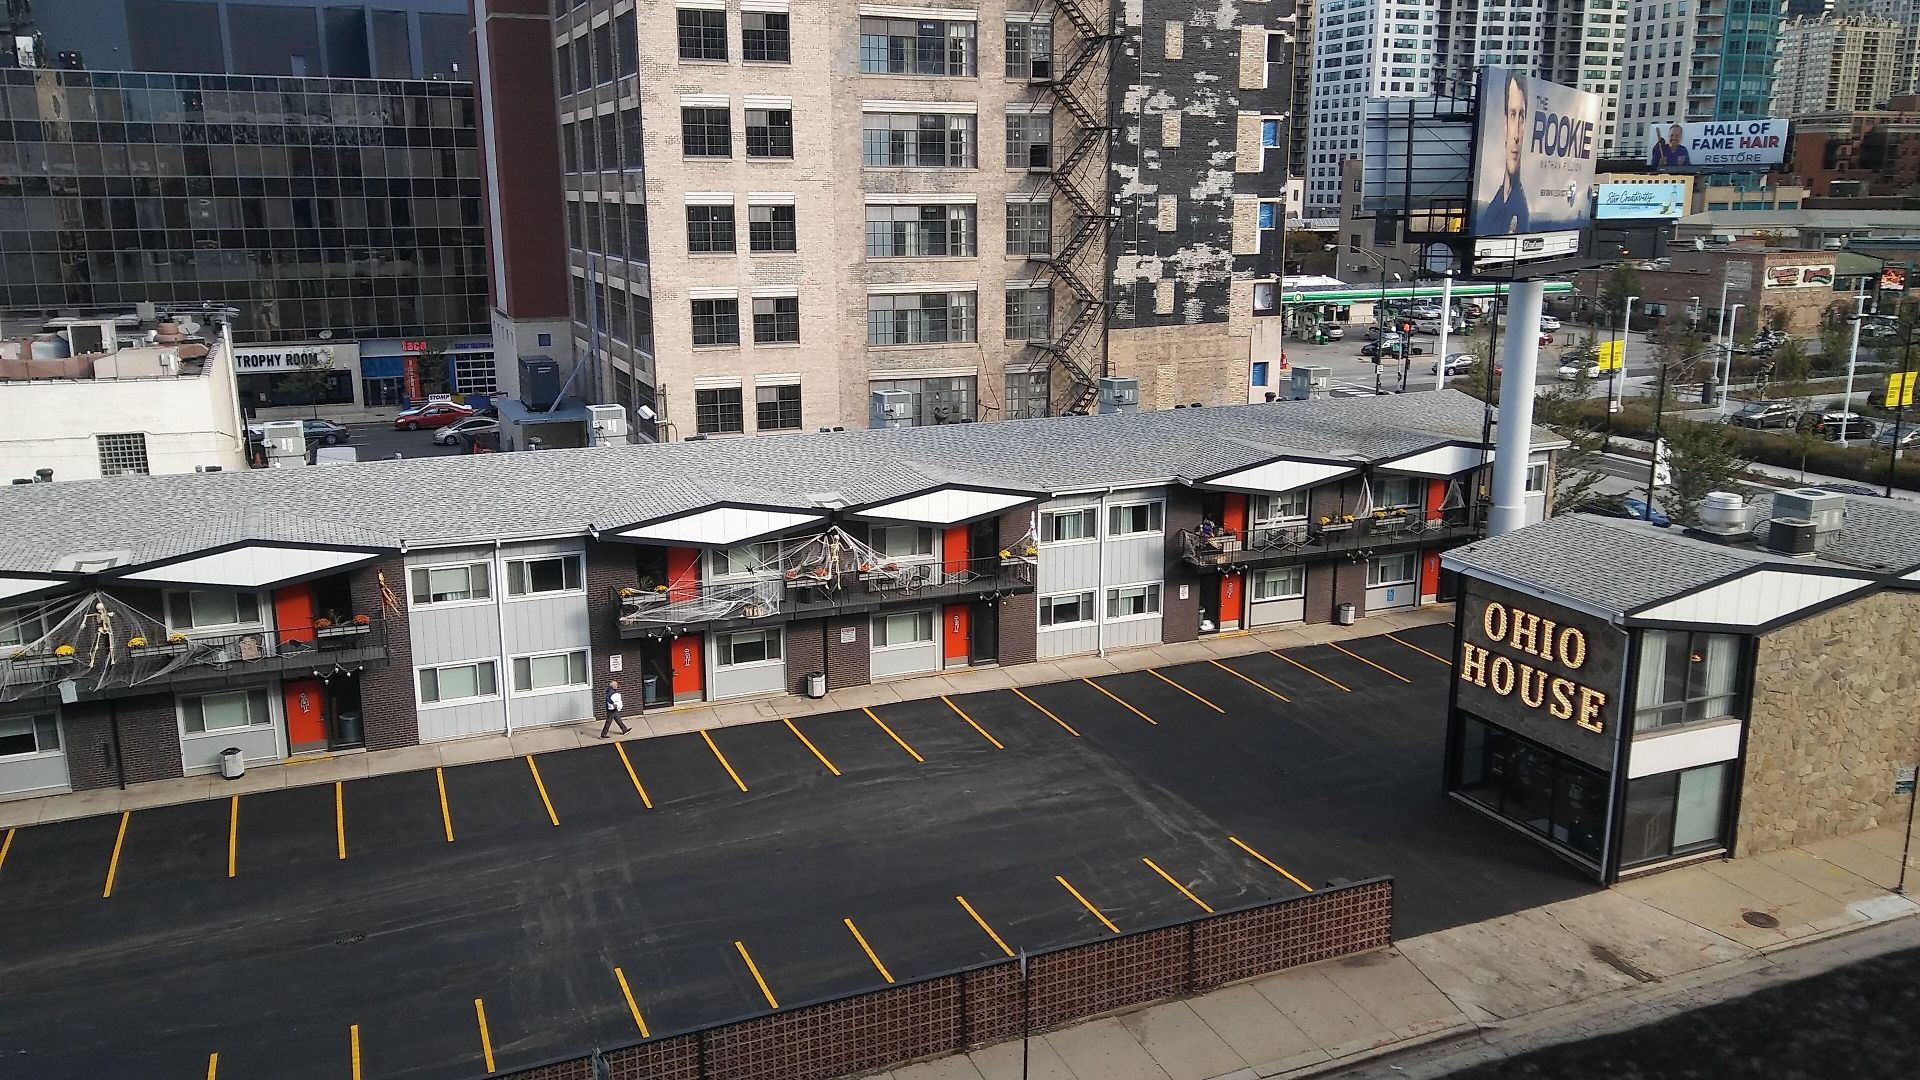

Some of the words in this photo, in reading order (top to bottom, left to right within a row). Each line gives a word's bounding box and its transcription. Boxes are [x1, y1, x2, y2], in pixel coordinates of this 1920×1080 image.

[1530, 110, 1594, 159] ROOKIE
[1692, 138, 1735, 150] FAME
[1739, 135, 1780, 149] HAIR
[1704, 124, 1743, 136] HALL
[1748, 123, 1771, 135] OF
[235, 354, 281, 368] TROPHY
[286, 352, 320, 366] ROOM
[1484, 601, 1586, 669] OHIO
[1461, 642, 1606, 733] HOUSE
